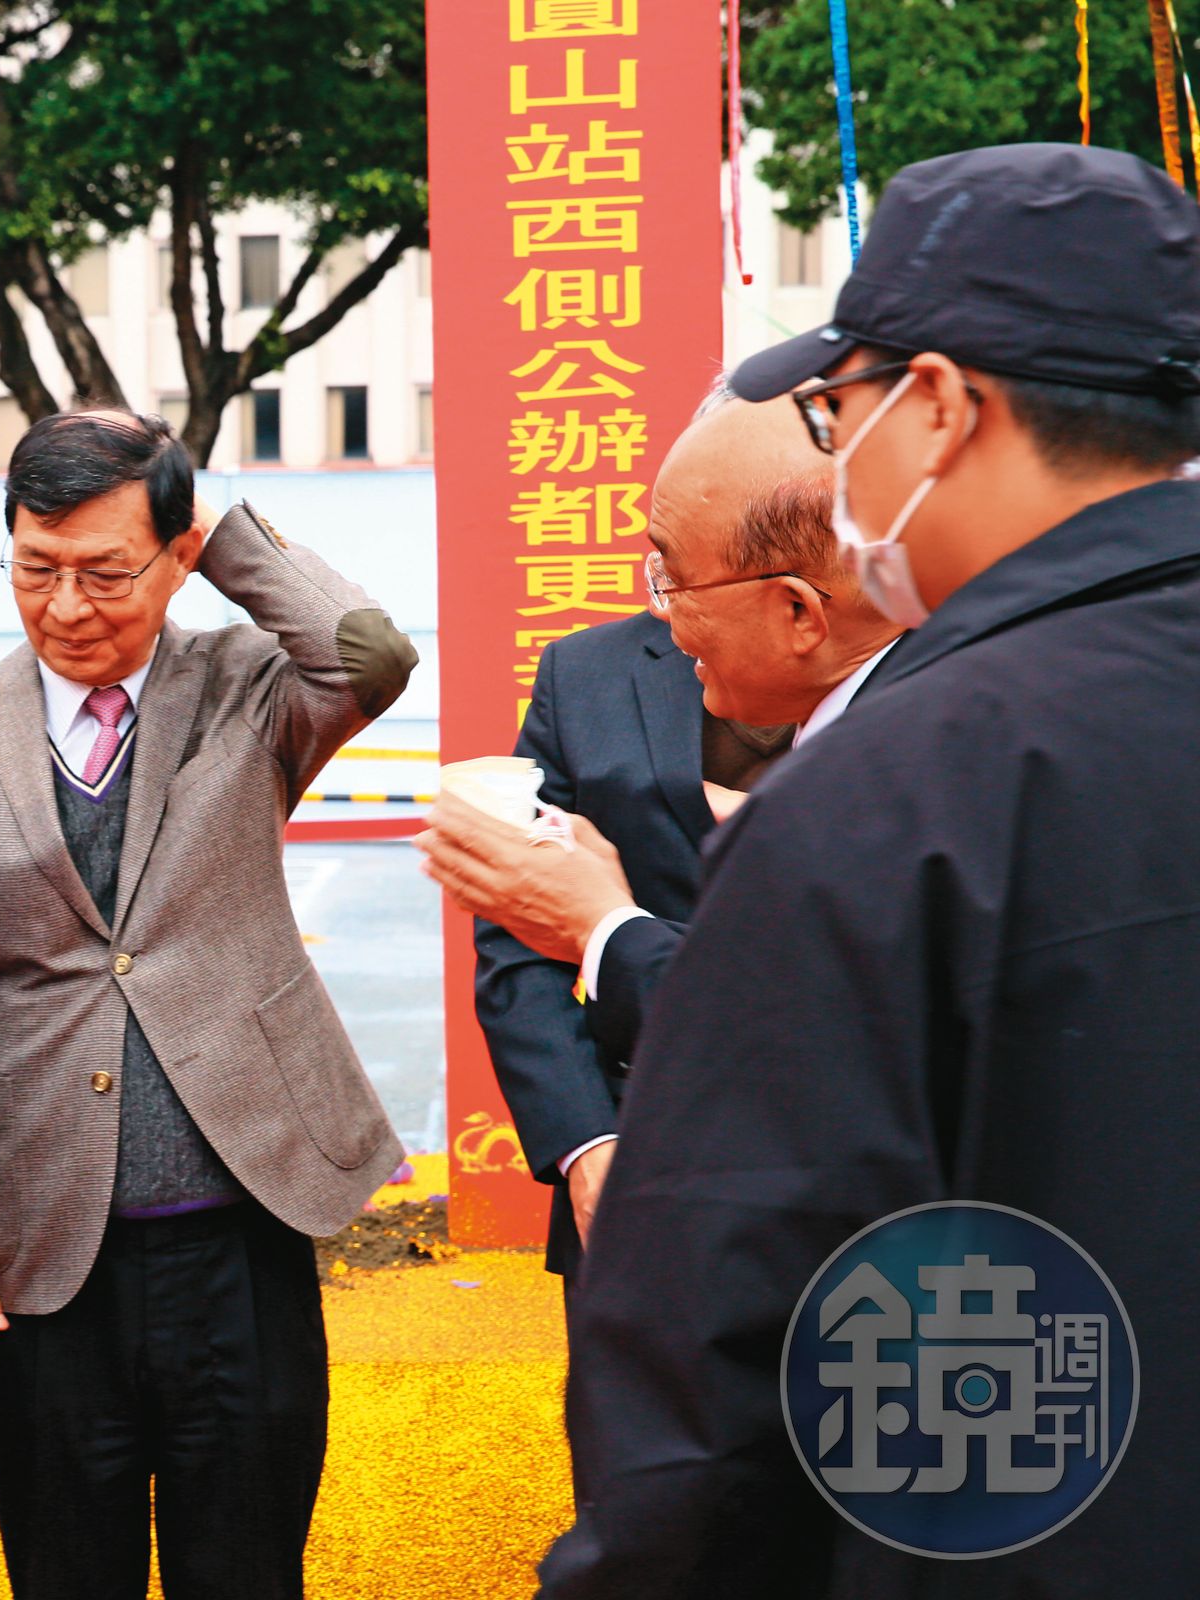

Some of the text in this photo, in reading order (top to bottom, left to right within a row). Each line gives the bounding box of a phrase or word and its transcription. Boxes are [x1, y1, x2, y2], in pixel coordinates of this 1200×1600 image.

[503, 0, 648, 731] 圓山站西側公辦都更
